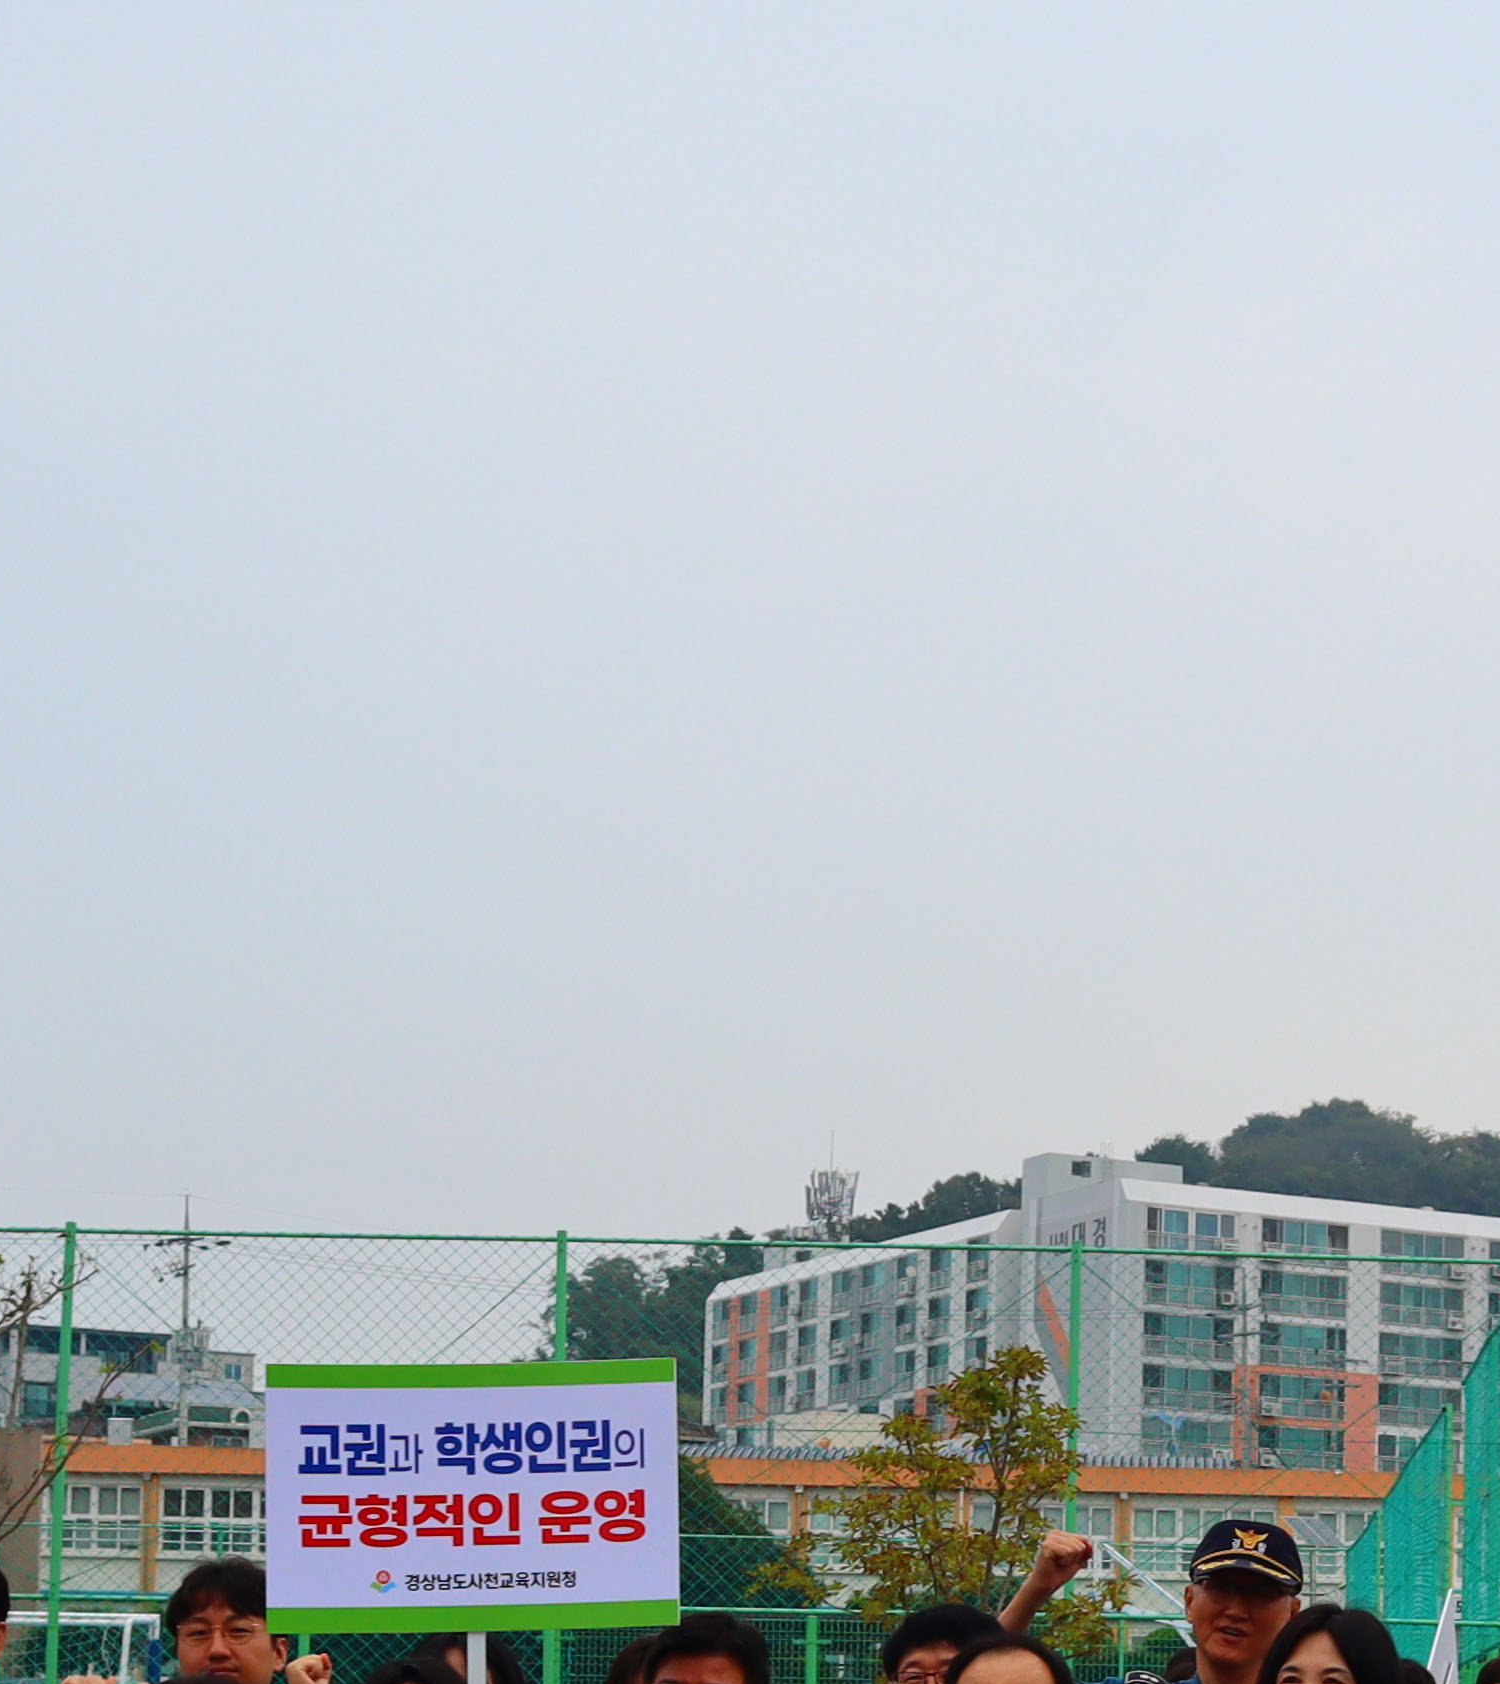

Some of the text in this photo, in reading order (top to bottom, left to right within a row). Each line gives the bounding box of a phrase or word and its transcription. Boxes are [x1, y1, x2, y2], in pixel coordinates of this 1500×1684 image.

[298, 1419, 646, 1476] 교권과 학생인권의
[298, 1488, 647, 1549] 균형적인 운영
[404, 1570, 577, 1593] 경상남도사천교육지원청
